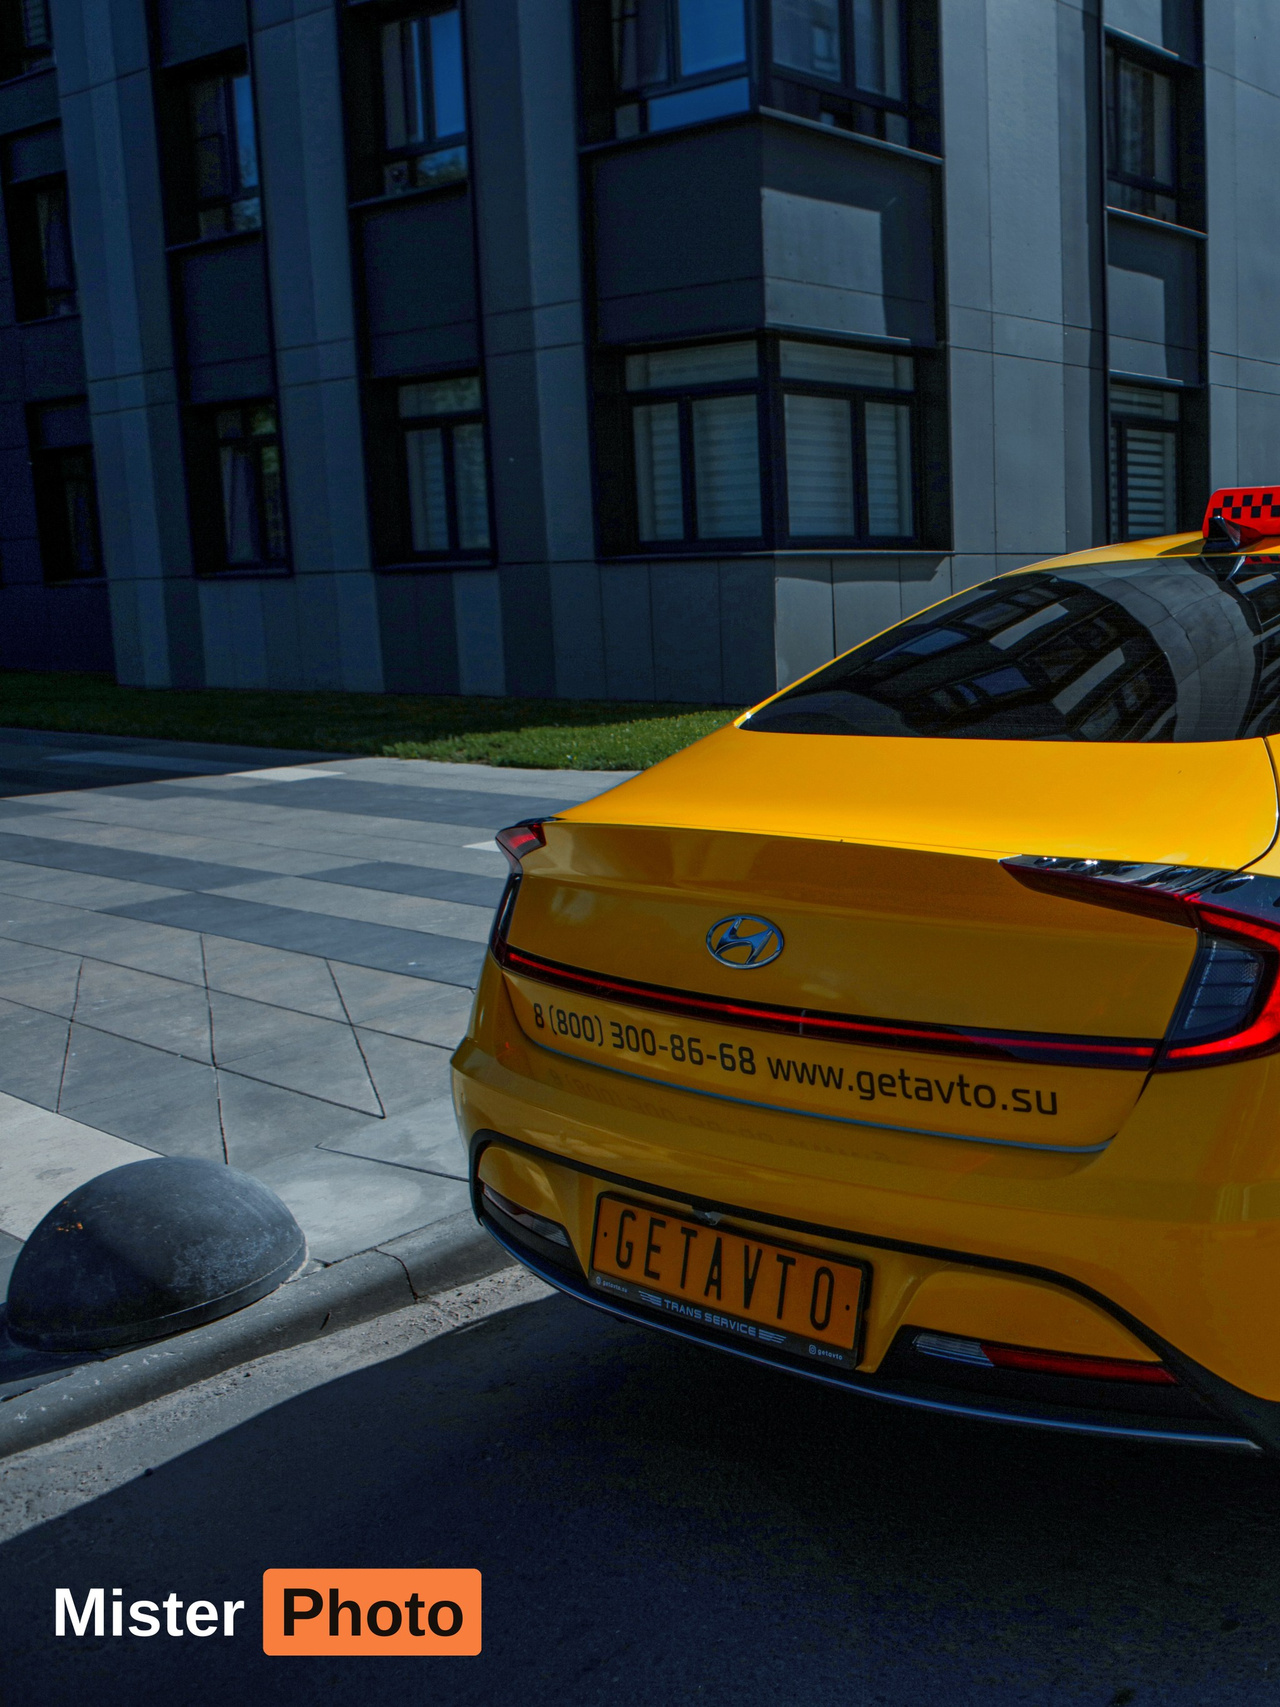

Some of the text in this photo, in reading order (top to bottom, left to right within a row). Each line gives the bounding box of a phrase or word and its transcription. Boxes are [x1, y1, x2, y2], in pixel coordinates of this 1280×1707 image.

[534, 1003, 1058, 1116] 8 (800) 300-86-68 www.getavto.su
[615, 1209, 835, 1331] GETAVTO
[664, 1299, 757, 1337] TRANS SERVICE
[817, 1348, 843, 1361] getavto
